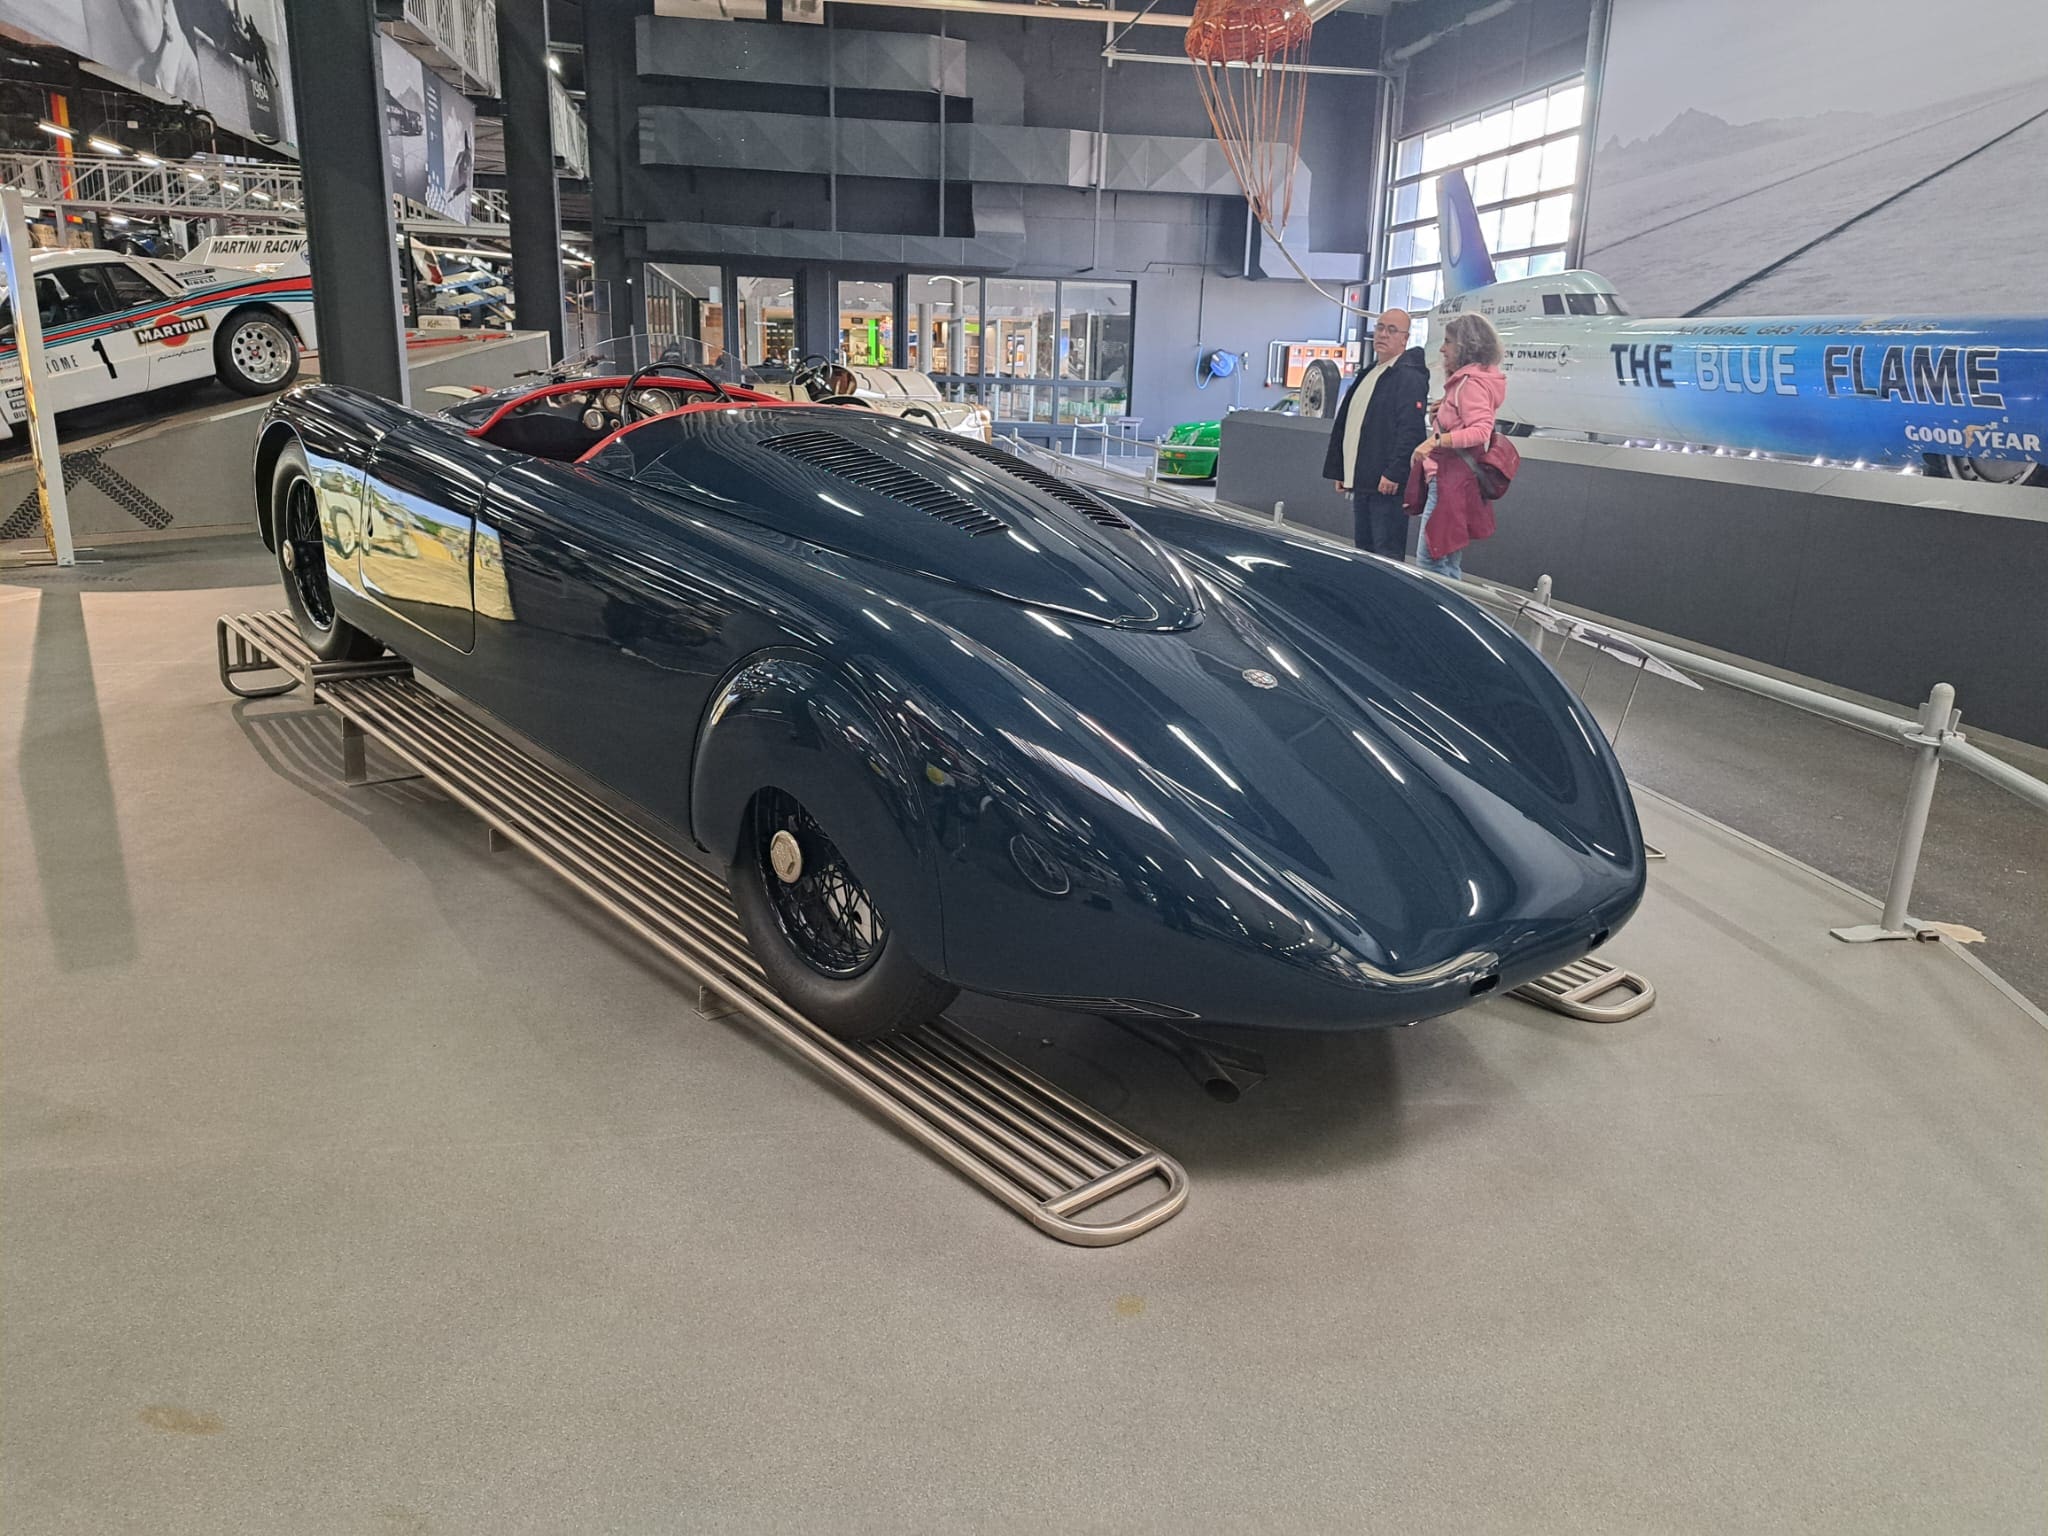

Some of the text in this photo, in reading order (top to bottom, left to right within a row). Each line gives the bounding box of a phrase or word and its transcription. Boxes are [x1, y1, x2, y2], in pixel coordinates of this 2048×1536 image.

[211, 240, 260, 254] MARTINI
[138, 318, 205, 343] MARTINI
[1756, 325, 1800, 336] GAS
[91, 338, 118, 379] 1
[1517, 350, 1558, 359] DYNAMICS
[1610, 343, 2006, 410] THE BLUE FLAME
